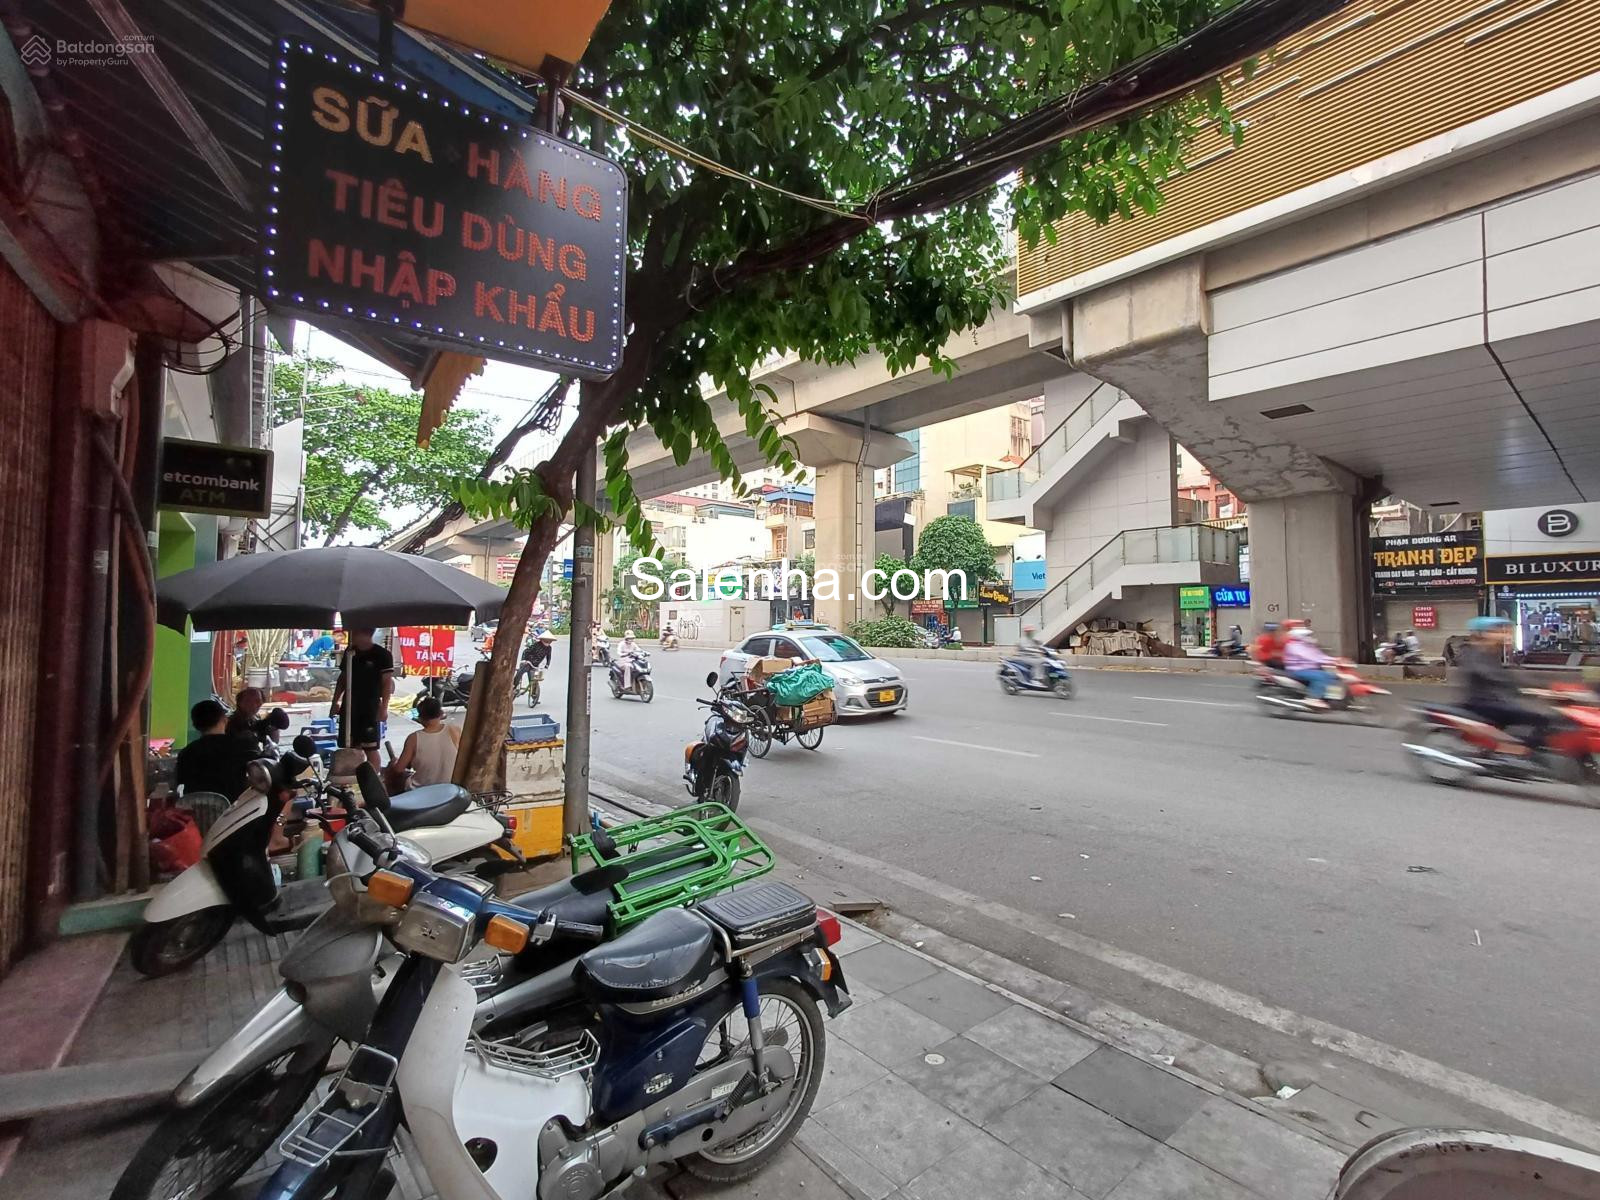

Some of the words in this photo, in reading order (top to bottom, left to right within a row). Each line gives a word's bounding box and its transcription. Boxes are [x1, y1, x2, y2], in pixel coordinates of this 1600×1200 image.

[312, 85, 434, 164] SỮA
[467, 141, 602, 222] HÀNG
[325, 168, 446, 239] TIÊU
[462, 210, 588, 282] DÙNG
[307, 238, 458, 309] NHẬP
[474, 280, 596, 343] KHẨU
[180, 488, 226, 504] ATM
[1373, 548, 1435, 568] TRANH
[1437, 546, 1478, 567] ĐẸP
[1504, 563, 1526, 575] BI
[1267, 603, 1280, 613] G1
